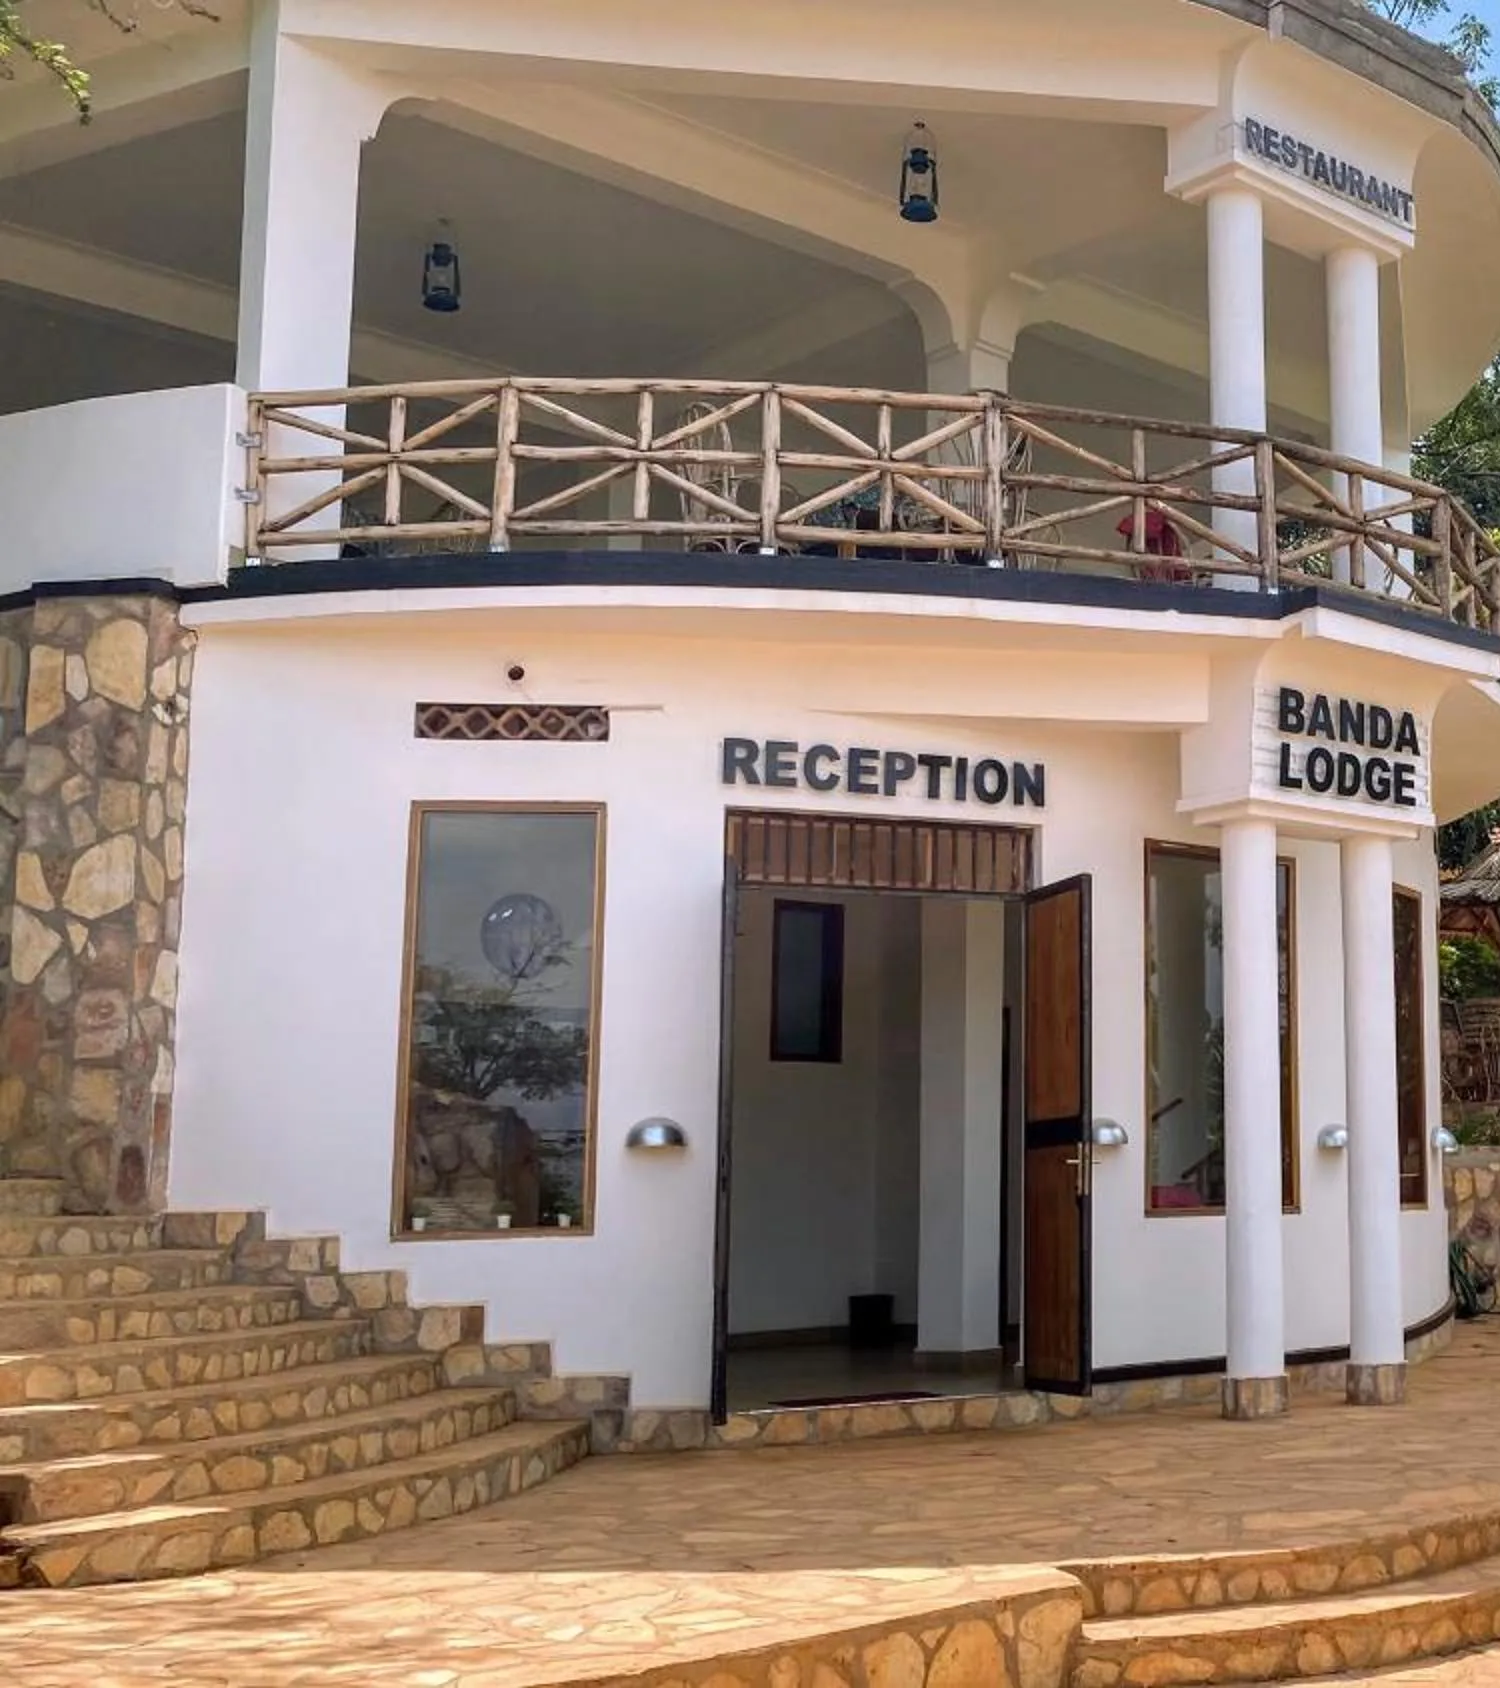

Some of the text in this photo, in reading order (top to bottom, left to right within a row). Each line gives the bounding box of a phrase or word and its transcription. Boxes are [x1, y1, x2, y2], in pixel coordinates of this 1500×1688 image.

[1245, 117, 1413, 222] RESTAURANT
[1278, 687, 1421, 757] BANDA
[722, 737, 1046, 808] RECEPTION
[1279, 742, 1416, 807] LODGE
